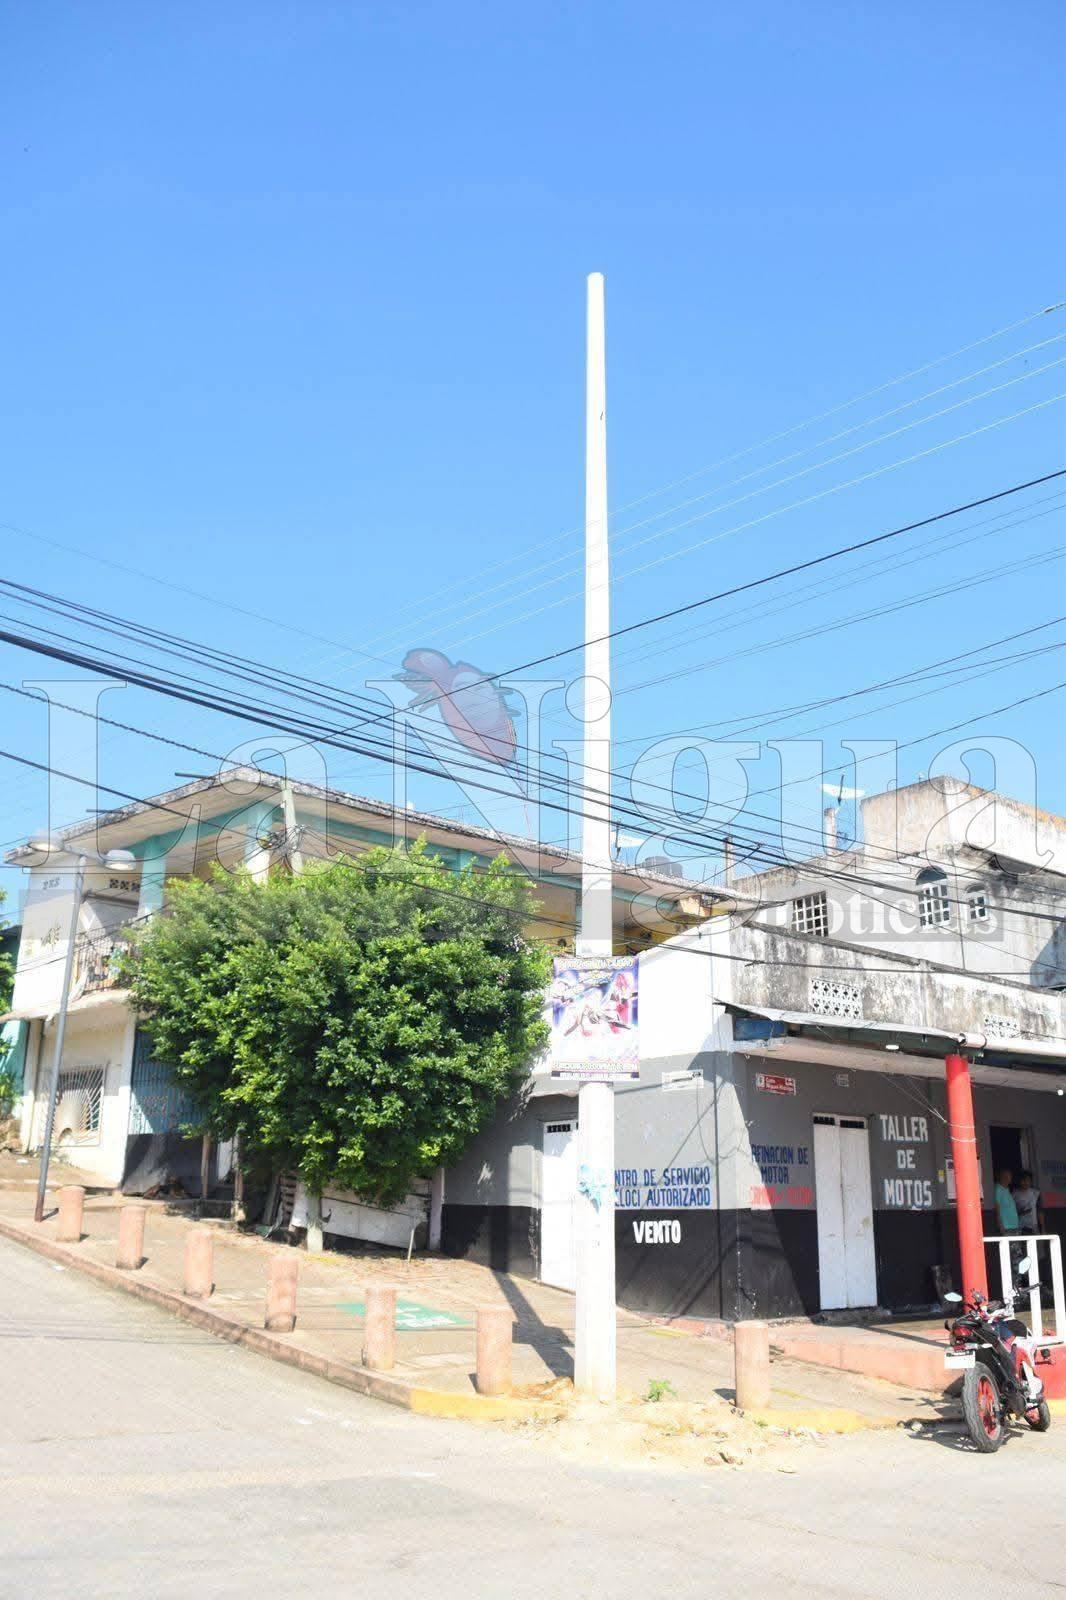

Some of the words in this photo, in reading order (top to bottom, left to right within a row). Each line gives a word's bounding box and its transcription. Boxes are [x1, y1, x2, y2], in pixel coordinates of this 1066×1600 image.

[880, 1114, 928, 1141] TALLER
[798, 1147, 808, 1165] DE
[896, 1149, 916, 1168] DE
[614, 1169, 638, 1187] NTRO
[643, 1168, 657, 1187] DE
[663, 1166, 710, 1187] SERVICIO
[761, 1166, 789, 1184] MOTOR
[647, 1187, 710, 1207] AUTORIZADO
[884, 1179, 932, 1206] MOTOS
[632, 1220, 681, 1243] VENTO
